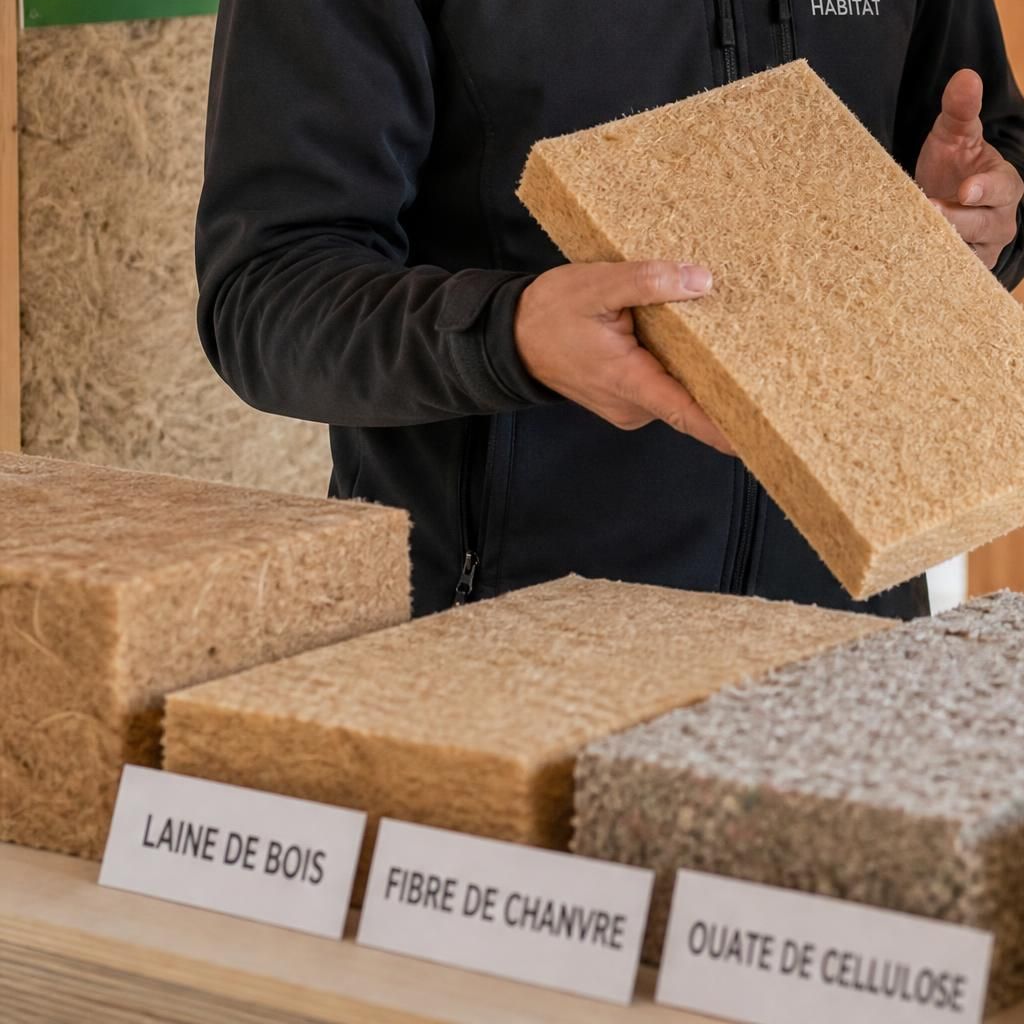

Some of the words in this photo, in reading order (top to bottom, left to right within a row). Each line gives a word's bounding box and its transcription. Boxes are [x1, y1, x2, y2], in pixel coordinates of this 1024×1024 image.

[142, 814, 219, 861] LAINE
[223, 832, 259, 870] DE
[264, 840, 326, 885] BOIS
[385, 867, 458, 913] FIBRE
[462, 883, 499, 922] DE
[504, 892, 627, 950] CHANVRE
[688, 920, 775, 971] OUATE
[780, 939, 816, 980] DE
[820, 948, 967, 1013] CELLULOSE
